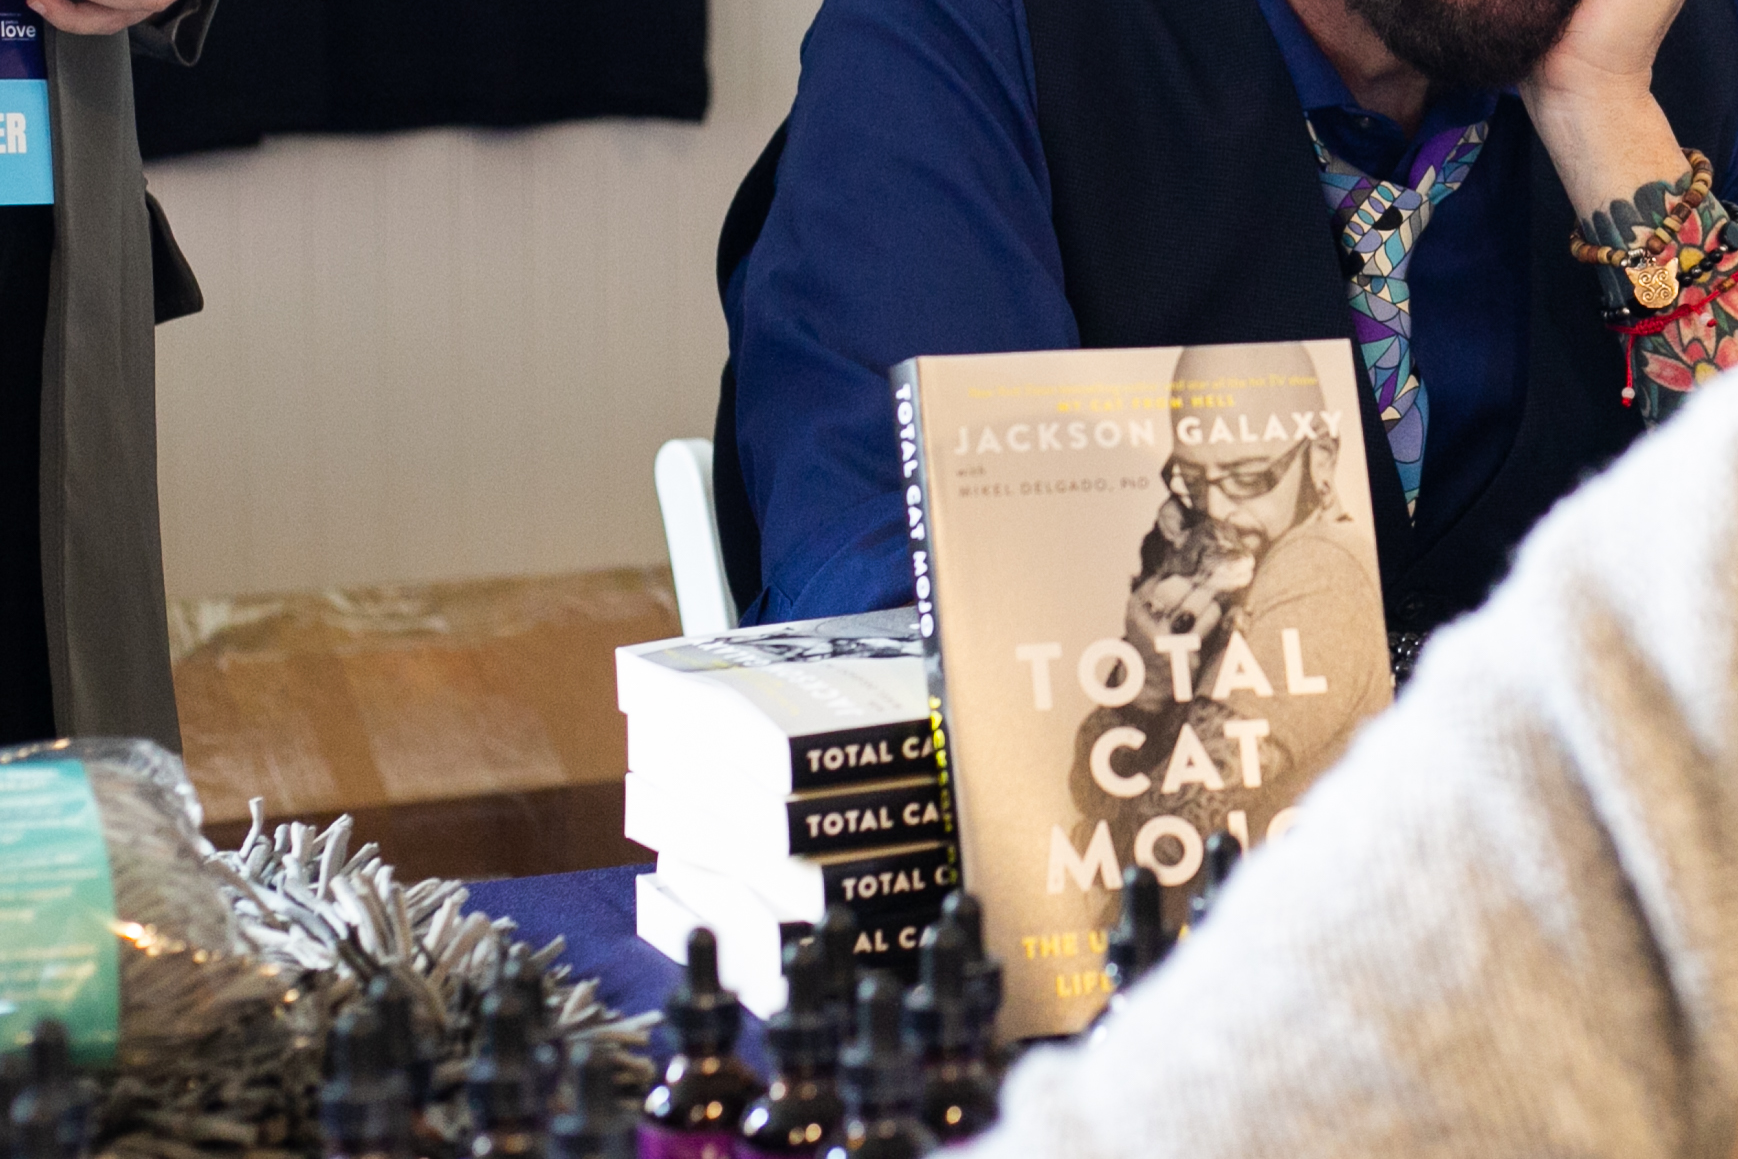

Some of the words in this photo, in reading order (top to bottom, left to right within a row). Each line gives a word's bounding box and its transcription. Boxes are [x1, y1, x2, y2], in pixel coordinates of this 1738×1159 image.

[1, 20, 36, 38] love
[1190, 394, 1235, 409] HELL
[896, 383, 919, 478] TOTAL
[953, 418, 1156, 456] JACKSON
[1176, 410, 1343, 446] GALAXY
[906, 485, 926, 541] CAT
[913, 550, 935, 639] MOJO
[1014, 627, 1329, 712] TOTAL
[806, 740, 894, 773] TOTAL
[902, 736, 934, 760] CA
[1089, 718, 1271, 799] CAT
[805, 806, 895, 838] TOTAL
[902, 801, 939, 826] CA
[1046, 806, 1304, 896] MO
[842, 868, 926, 901] TOTAL
[1021, 931, 1079, 960] THE
